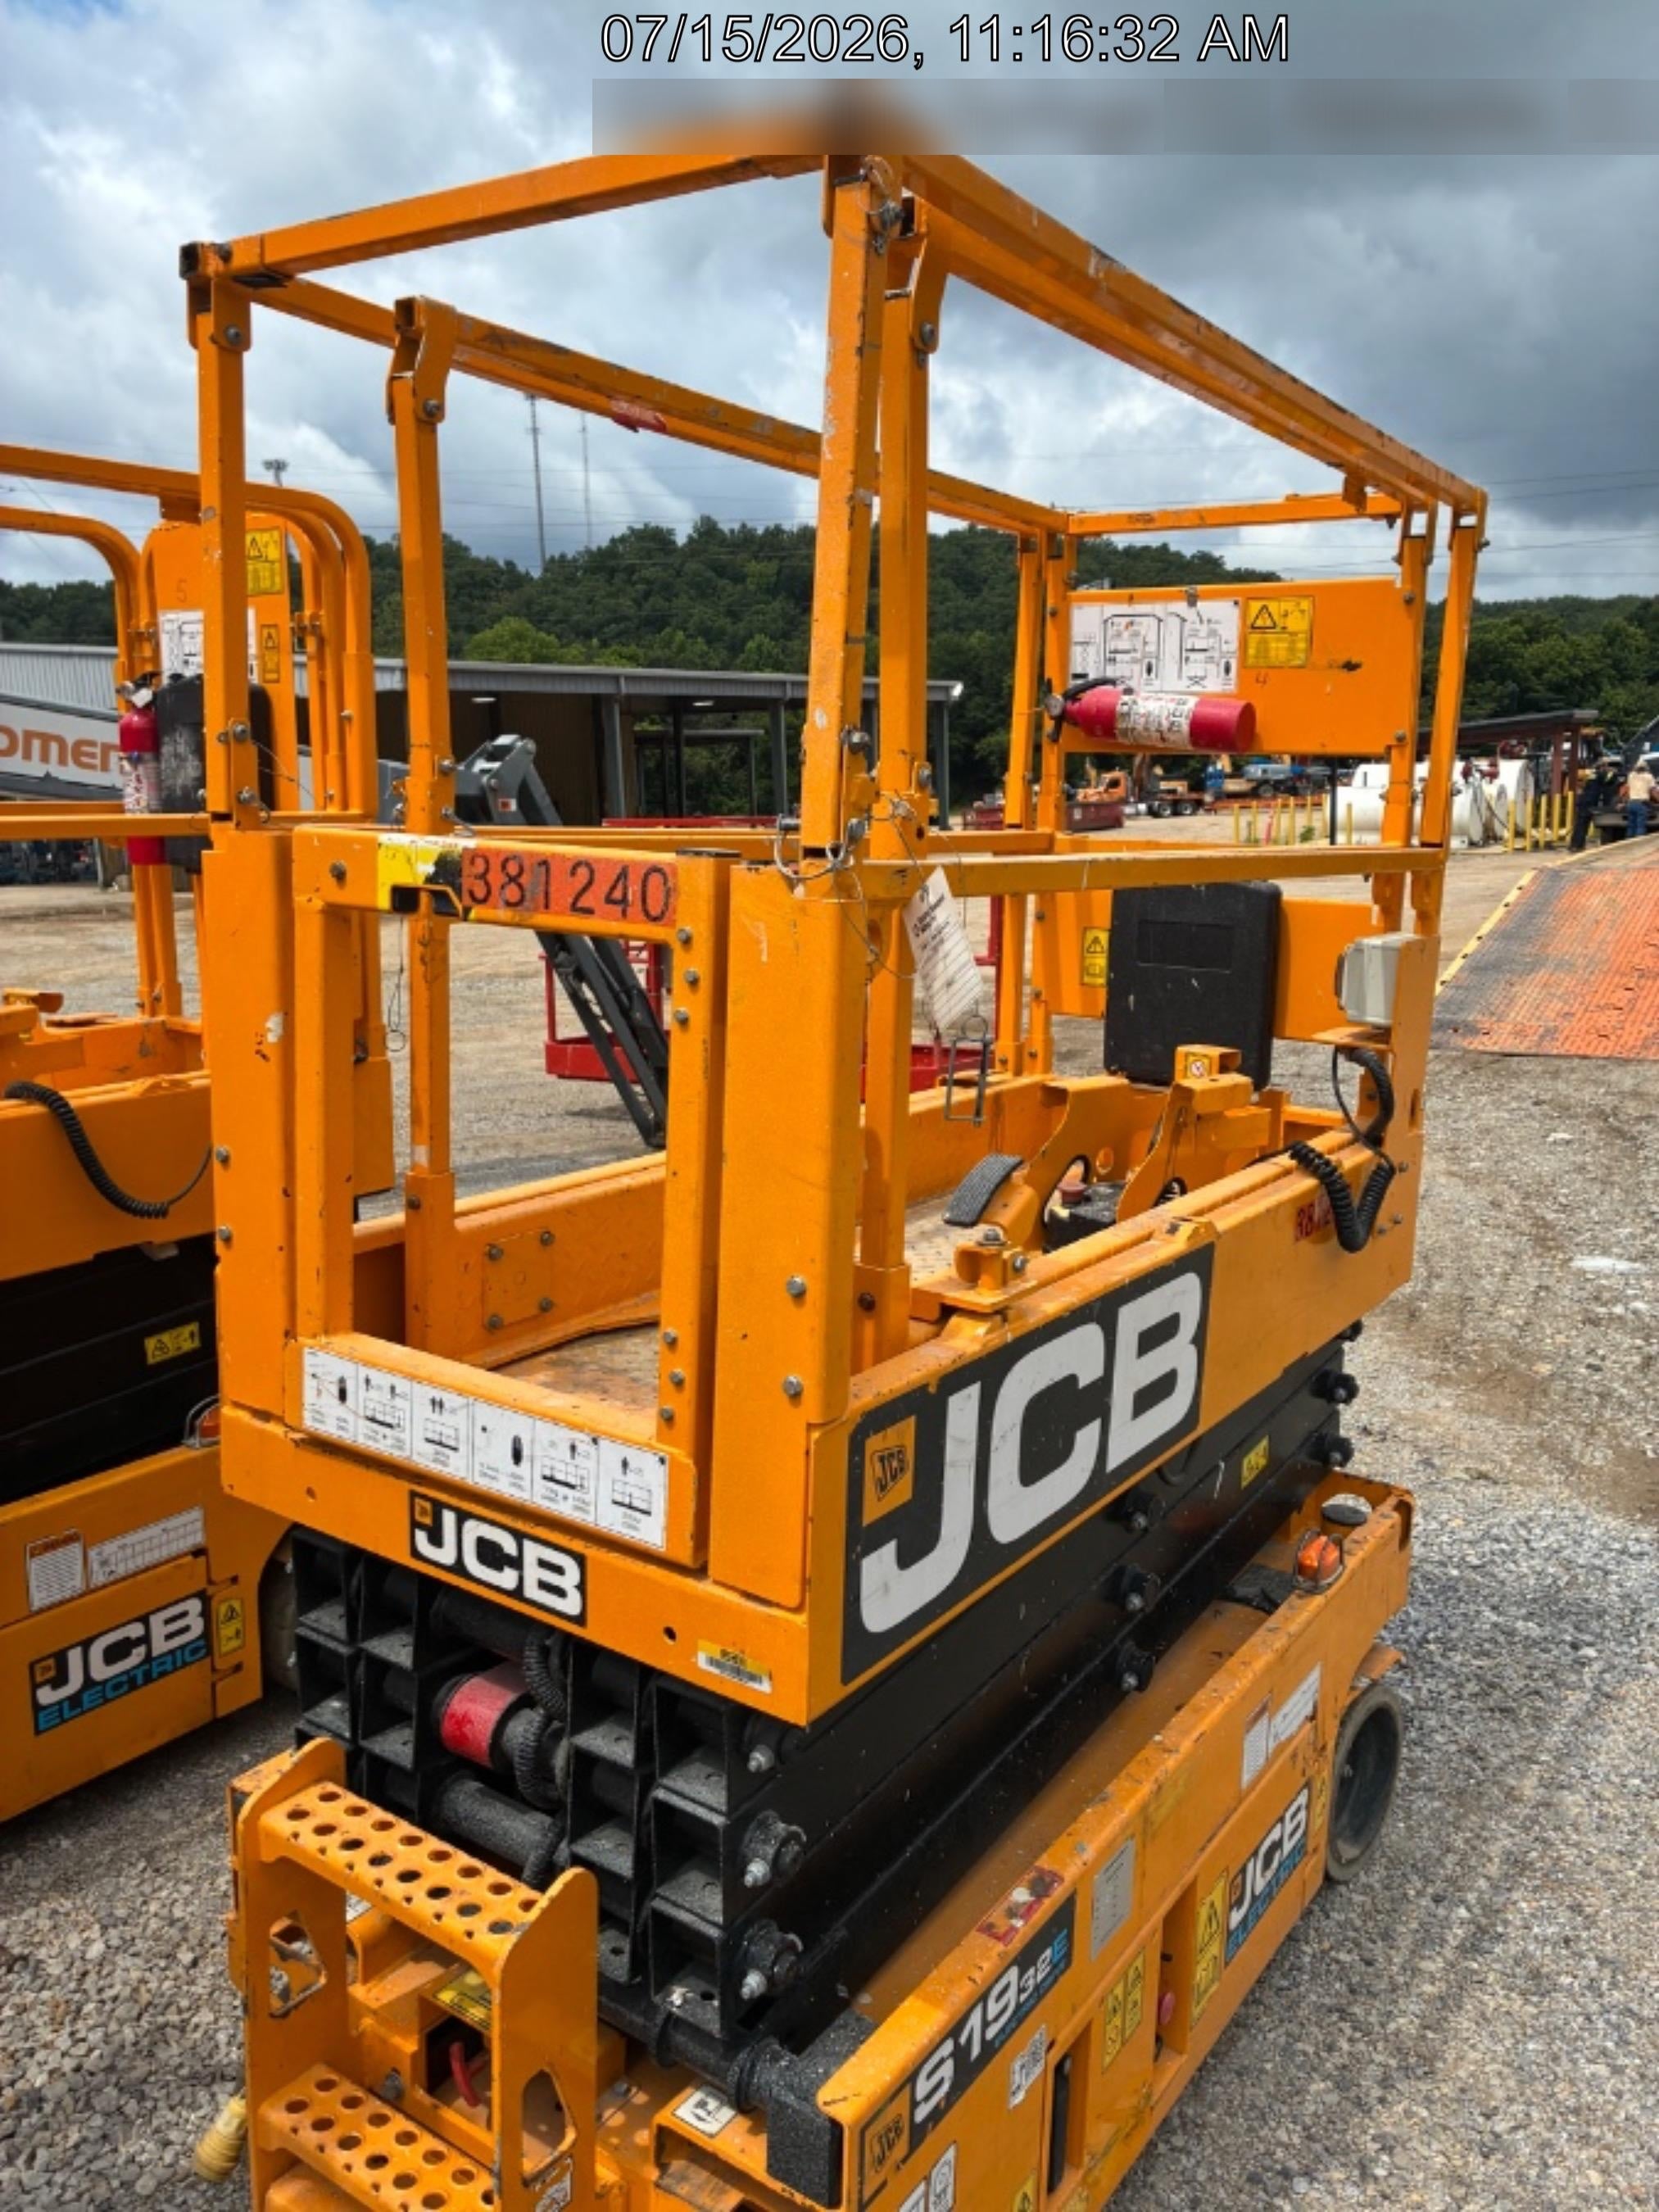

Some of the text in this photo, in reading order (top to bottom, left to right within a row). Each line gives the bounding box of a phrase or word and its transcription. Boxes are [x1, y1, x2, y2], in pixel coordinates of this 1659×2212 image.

[467, 854, 672, 923] 381240
[859, 1271, 1202, 1634] JCB
[873, 1448, 906, 1494] JCB
[414, 1507, 583, 1616] JCB
[35, 1594, 205, 1707] JCB
[38, 1639, 206, 1731] ELECTRIC
[1230, 1788, 1308, 1931] JCB
